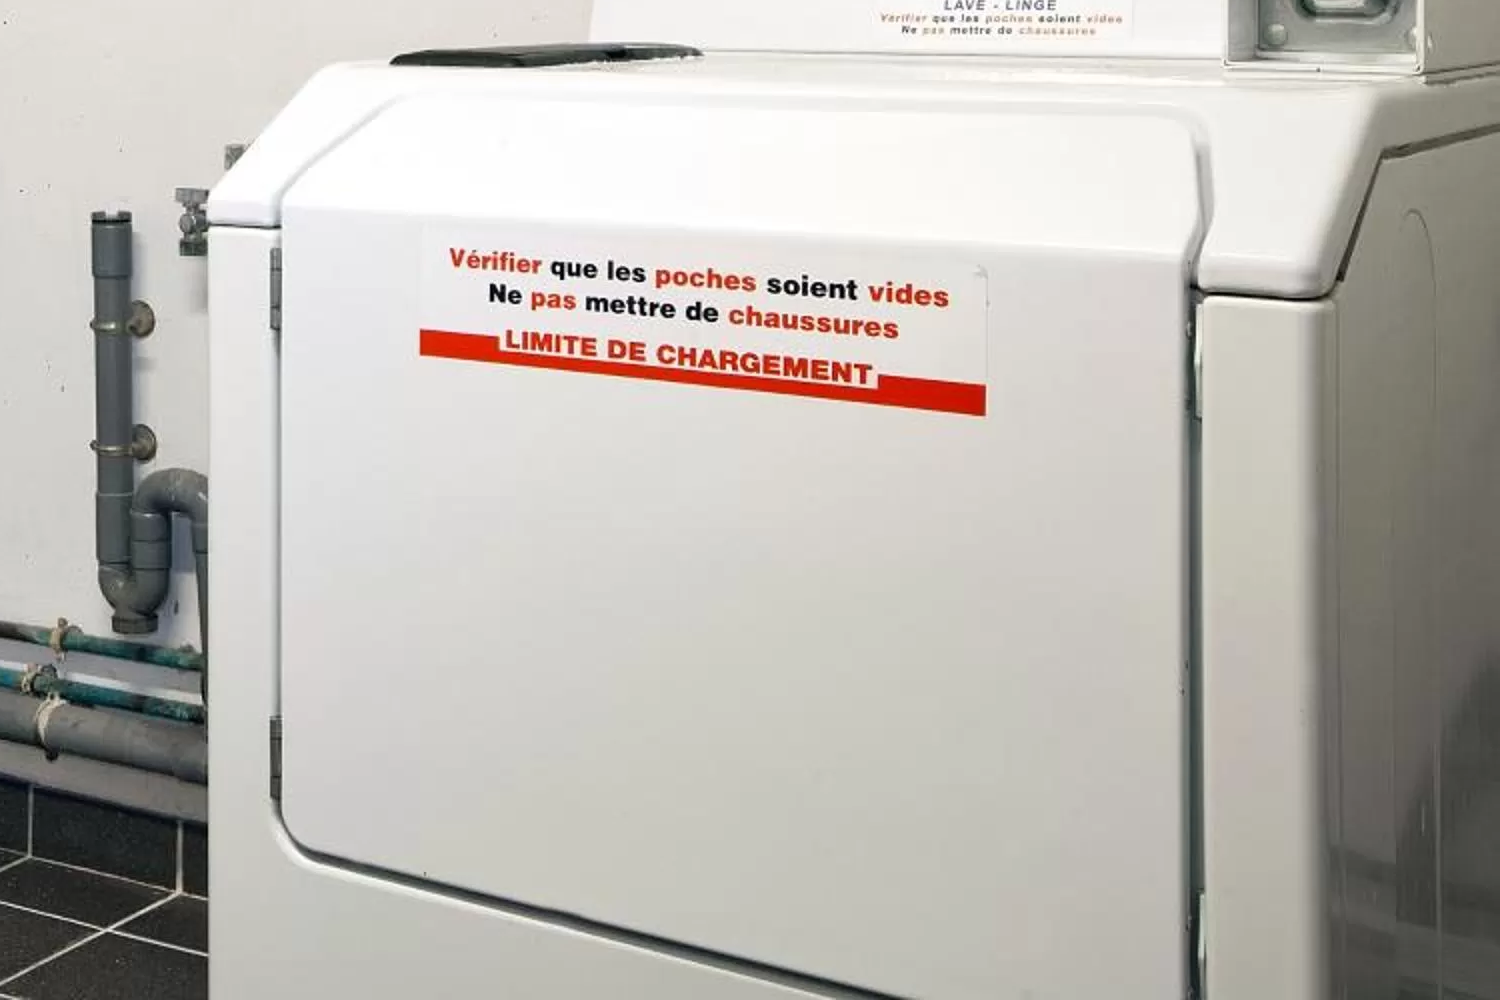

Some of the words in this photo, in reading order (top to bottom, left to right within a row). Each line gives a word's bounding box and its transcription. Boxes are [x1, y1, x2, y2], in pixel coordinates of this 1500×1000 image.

[932, 15, 955, 24] que
[961, 14, 979, 23] les
[985, 14, 1033, 24] poches
[1038, 14, 1081, 23] soient
[943, 0, 986, 11] LAVE
[1005, 0, 1057, 11] LINGE
[901, 26, 917, 34] Ne
[950, 26, 991, 35] mettre
[997, 26, 1013, 35] de
[1019, 26, 1096, 35] chaussures
[450, 247, 543, 276] Vérifier
[550, 260, 598, 281] que
[607, 261, 646, 283] les
[655, 267, 757, 292] poches
[766, 274, 859, 301] soient
[868, 282, 950, 308] vides
[489, 283, 523, 305] Ne
[531, 290, 577, 312] pas
[585, 294, 676, 320] mettre
[686, 301, 719, 323] de
[728, 306, 900, 339] chaussures
[505, 330, 597, 357] LIMITE
[607, 340, 647, 362] DE
[656, 346, 873, 385] CHARGEMENT
